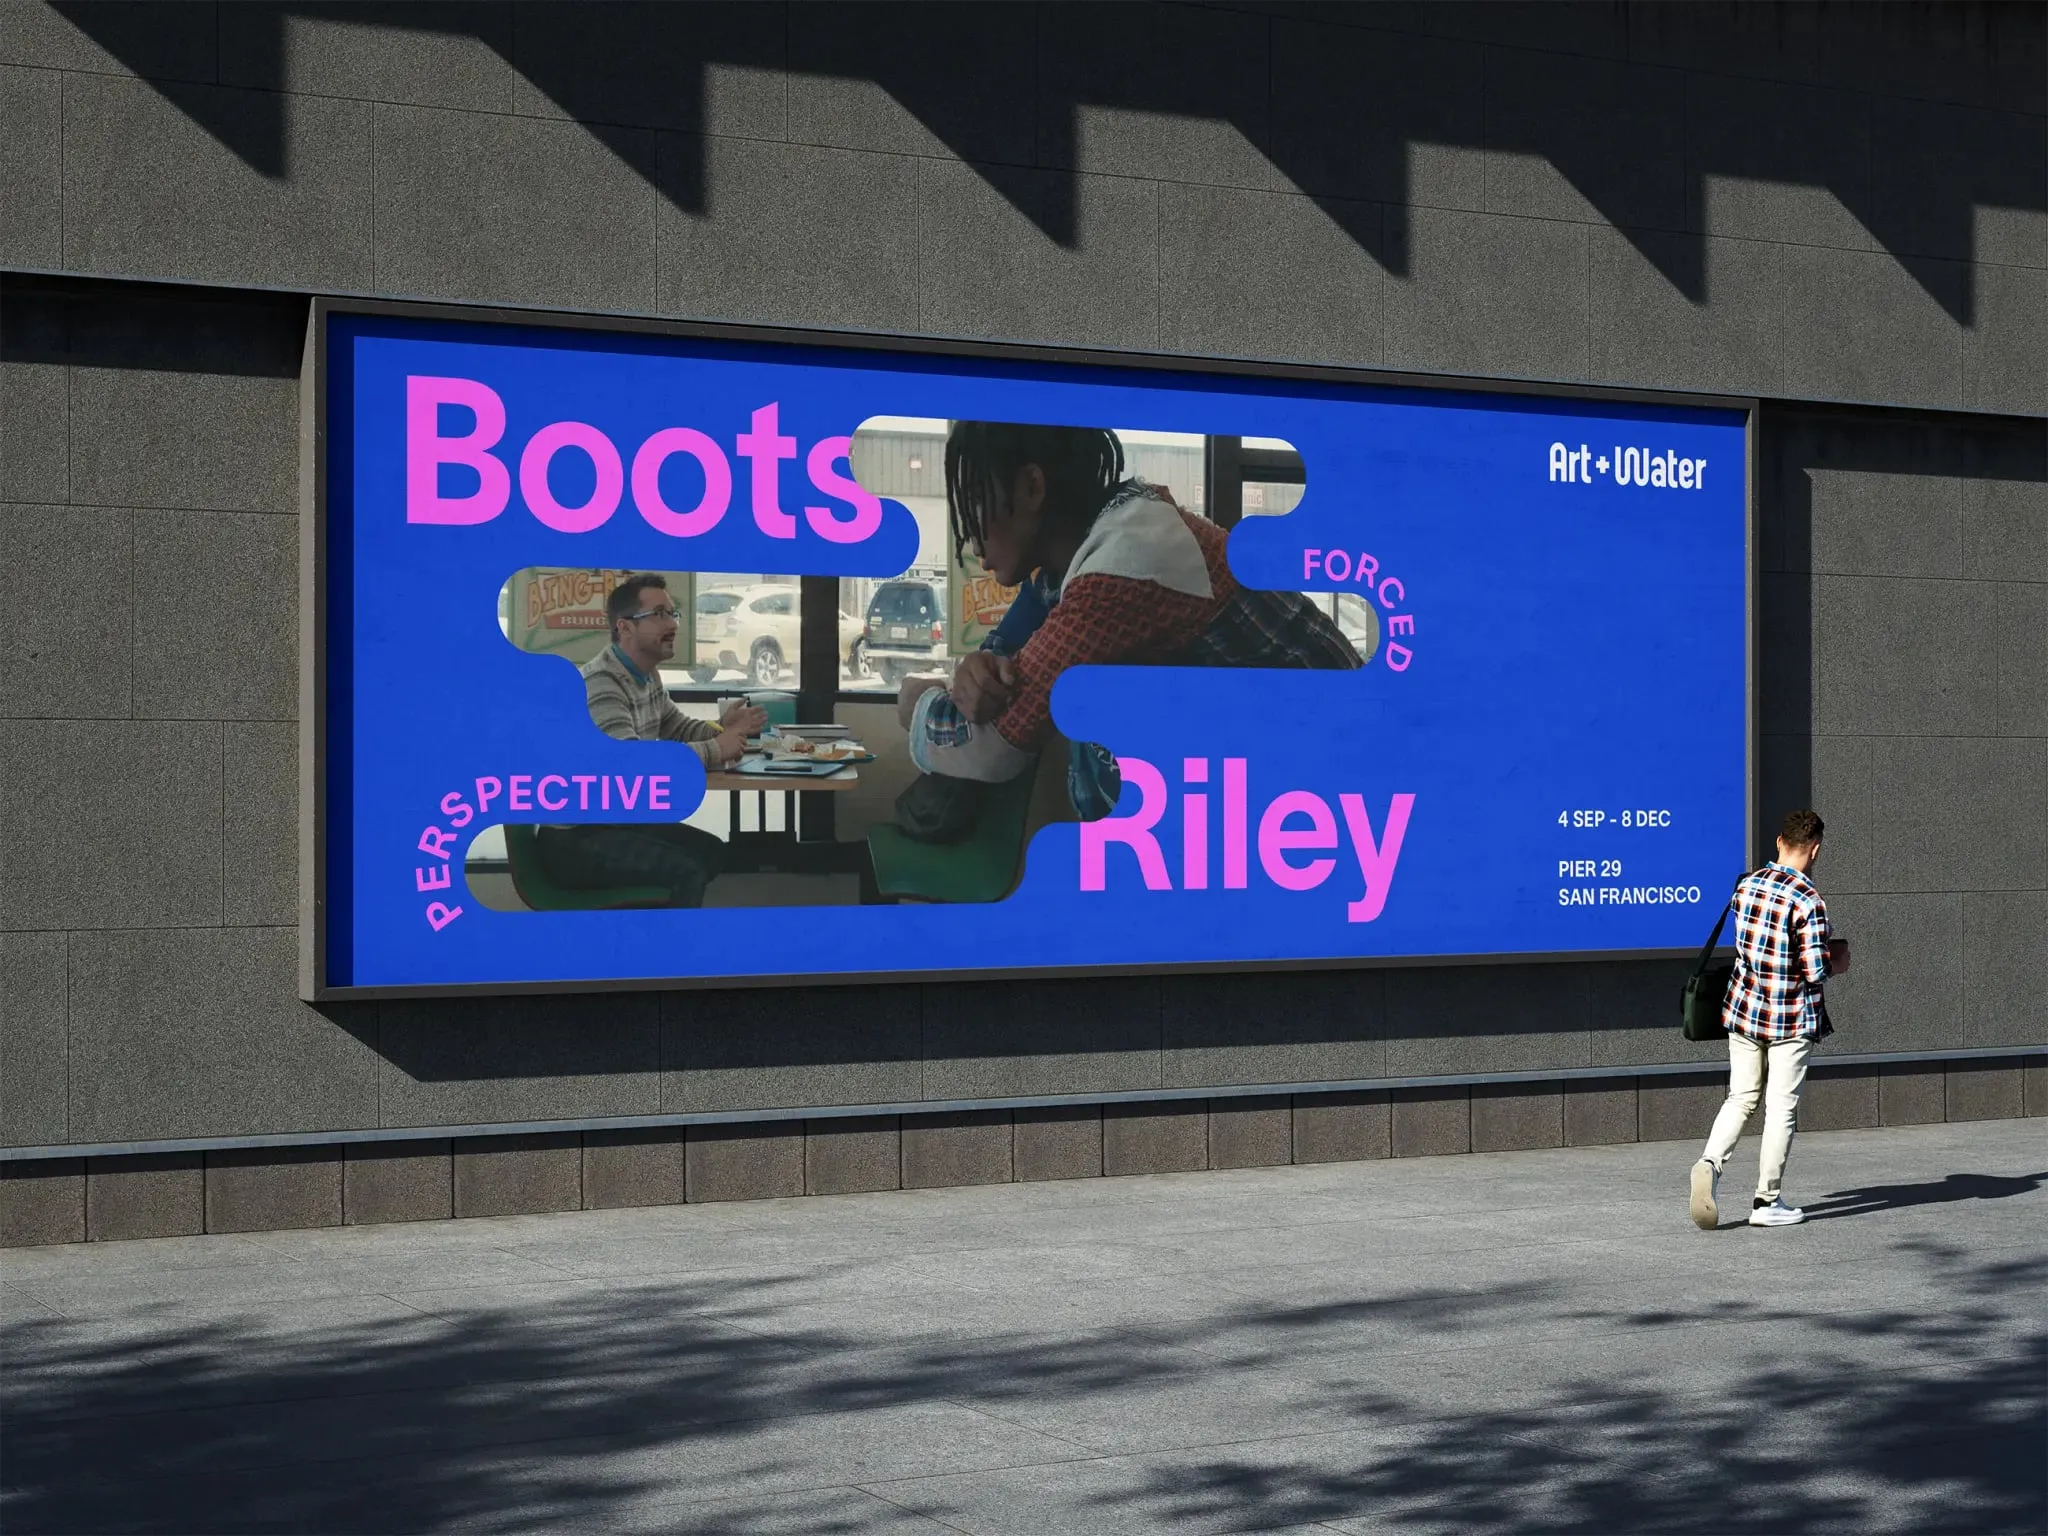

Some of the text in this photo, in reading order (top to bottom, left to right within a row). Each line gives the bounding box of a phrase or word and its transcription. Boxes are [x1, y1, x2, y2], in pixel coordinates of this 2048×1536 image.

[407, 375, 883, 544] Boots
[1549, 442, 1592, 484] Art
[1614, 446, 1707, 490] Water
[1303, 549, 1415, 672] FORCED
[415, 774, 671, 932] PERSPECTIVE
[1079, 757, 1417, 923] Riley
[1557, 810, 1569, 828] 4
[1572, 809, 1606, 828] SEP
[1621, 809, 1632, 828] 8
[1636, 809, 1671, 828] DEC
[1558, 859, 1622, 878] PIER 29
[1558, 886, 1701, 906] SAN FRANCISCO
